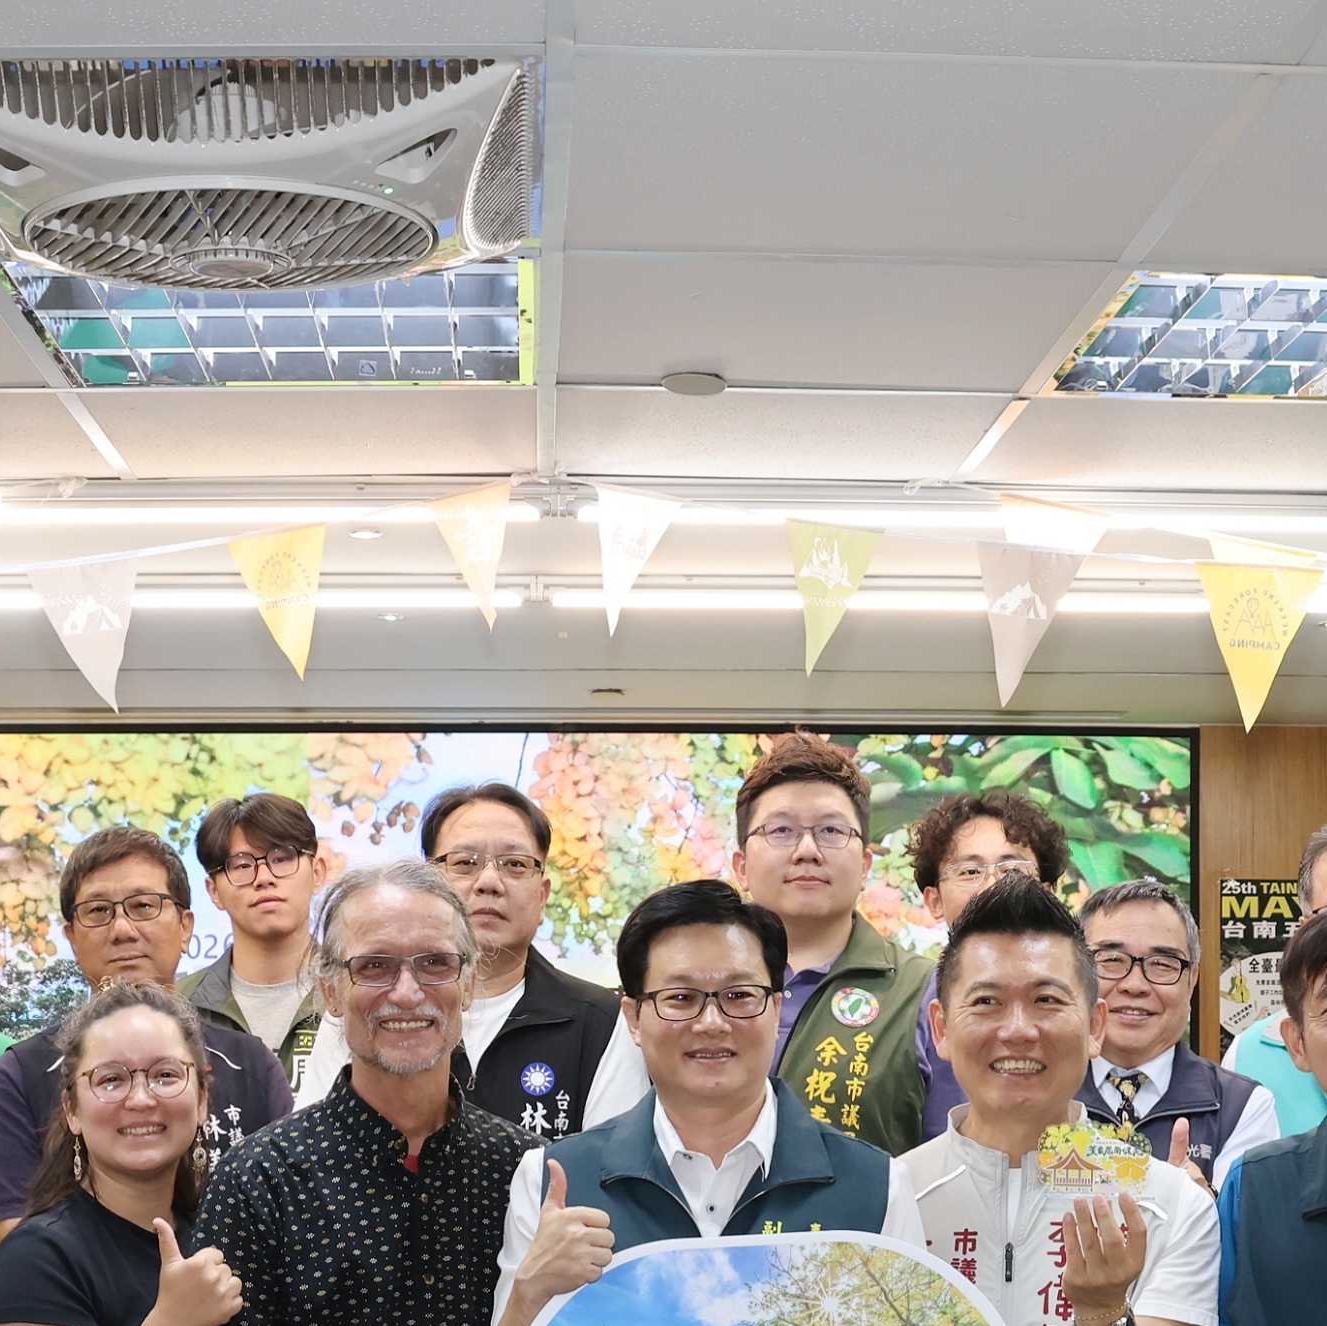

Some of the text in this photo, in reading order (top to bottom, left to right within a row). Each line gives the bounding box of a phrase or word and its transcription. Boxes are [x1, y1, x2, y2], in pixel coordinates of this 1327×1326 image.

[1221, 881, 1298, 895] 25th TAIN
[1221, 920, 1301, 940] 台南五
[840, 1031, 874, 1139] 台南市議
